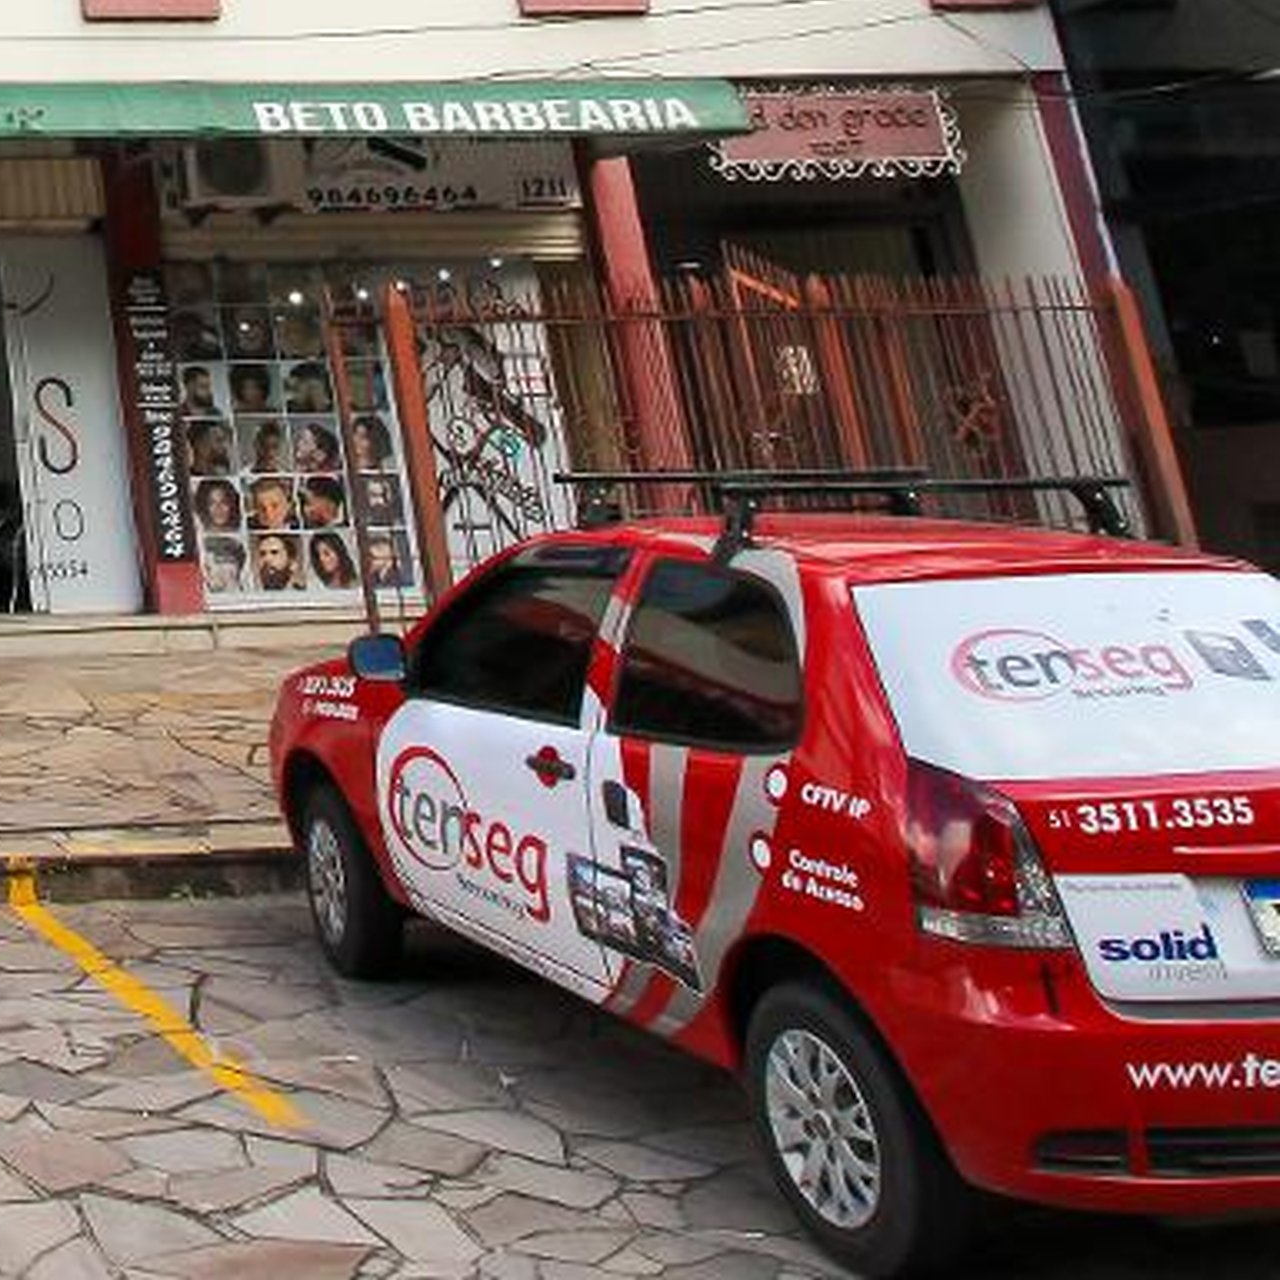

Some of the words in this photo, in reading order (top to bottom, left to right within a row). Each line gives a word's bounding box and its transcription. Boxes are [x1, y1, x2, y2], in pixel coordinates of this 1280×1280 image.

[253, 102, 387, 132] BETO
[402, 98, 698, 130] BARBEARIA
[966, 646, 1195, 691] tenseg
[1049, 808, 1072, 828] 51
[1077, 796, 1255, 834] 3511.3535
[398, 776, 551, 923] tenseg
[1098, 923, 1219, 961] solid
